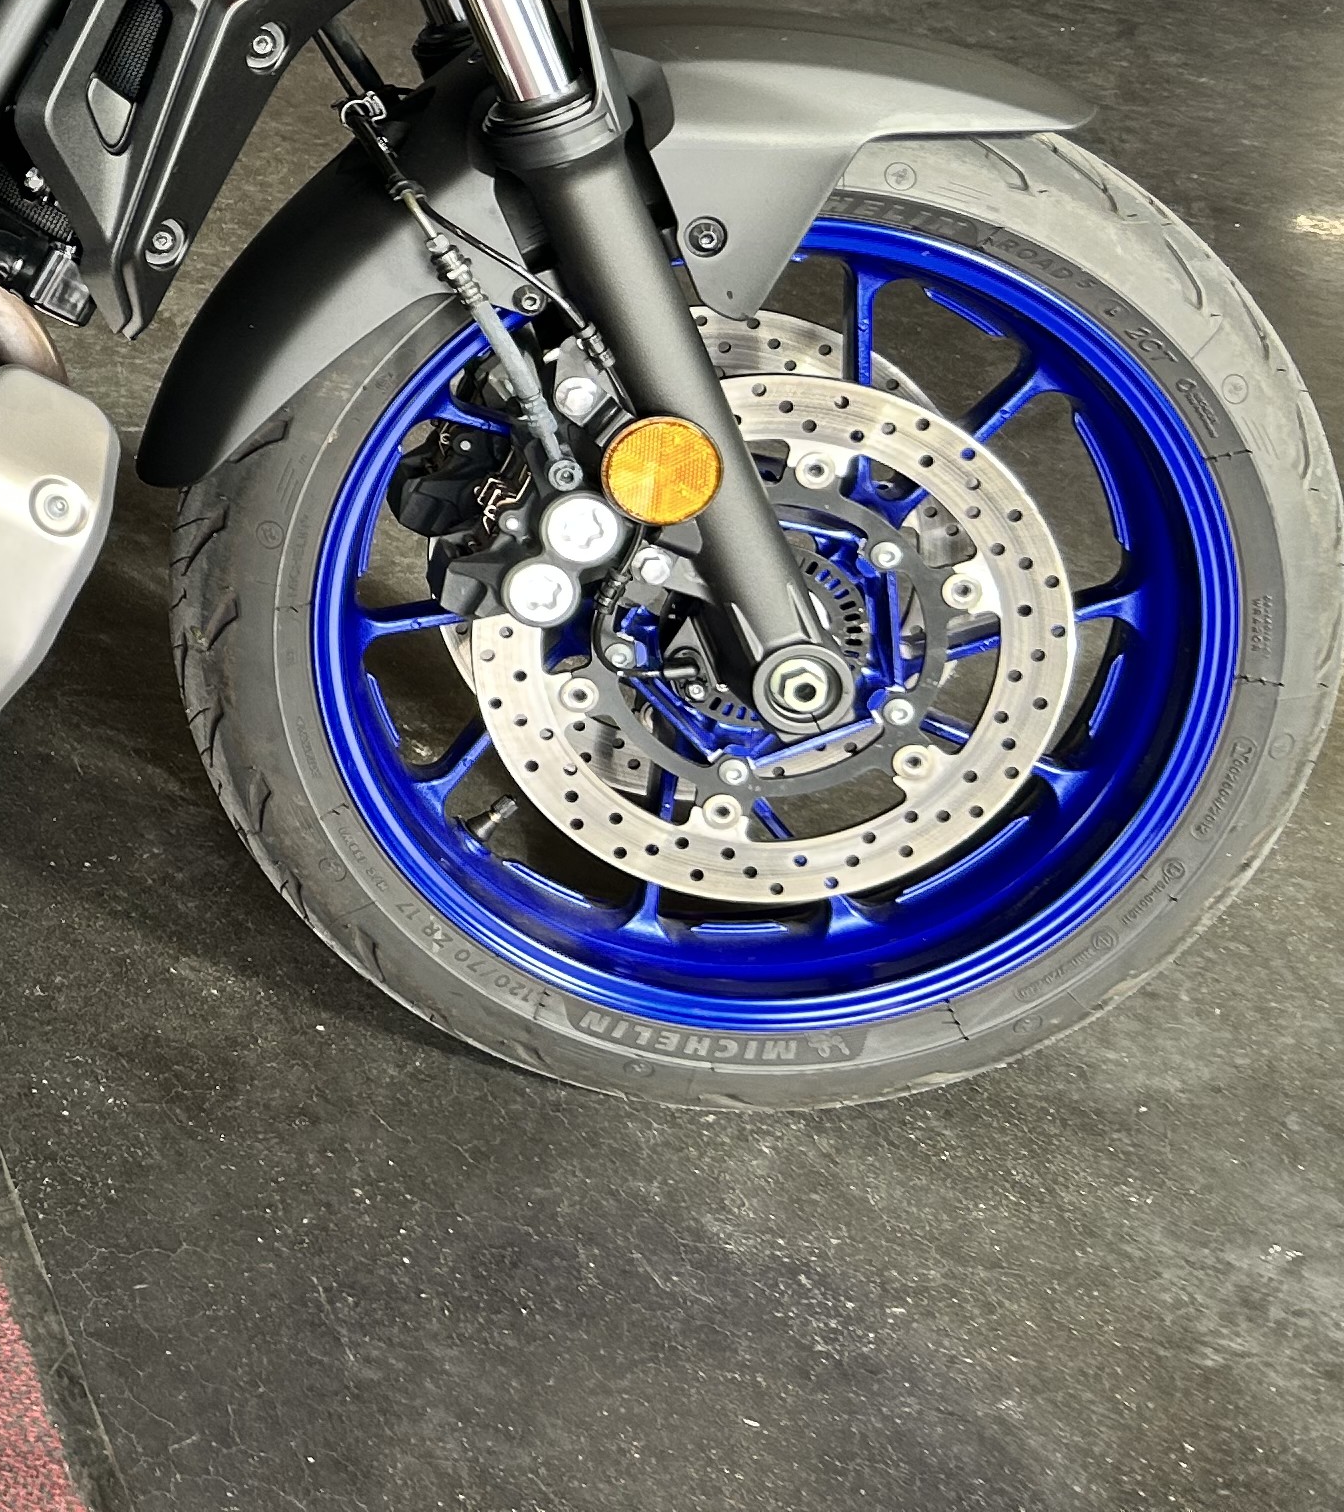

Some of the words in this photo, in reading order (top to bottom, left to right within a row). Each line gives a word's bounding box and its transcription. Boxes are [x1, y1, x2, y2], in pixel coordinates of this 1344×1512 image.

[826, 194, 972, 237] HELIN
[998, 238, 1072, 281] ROAD
[1124, 326, 1179, 364] 2CT
[394, 899, 421, 922] 17
[422, 918, 454, 949] ZR
[452, 946, 542, 1005] 120/70
[578, 1011, 799, 1060] MICHELIN
